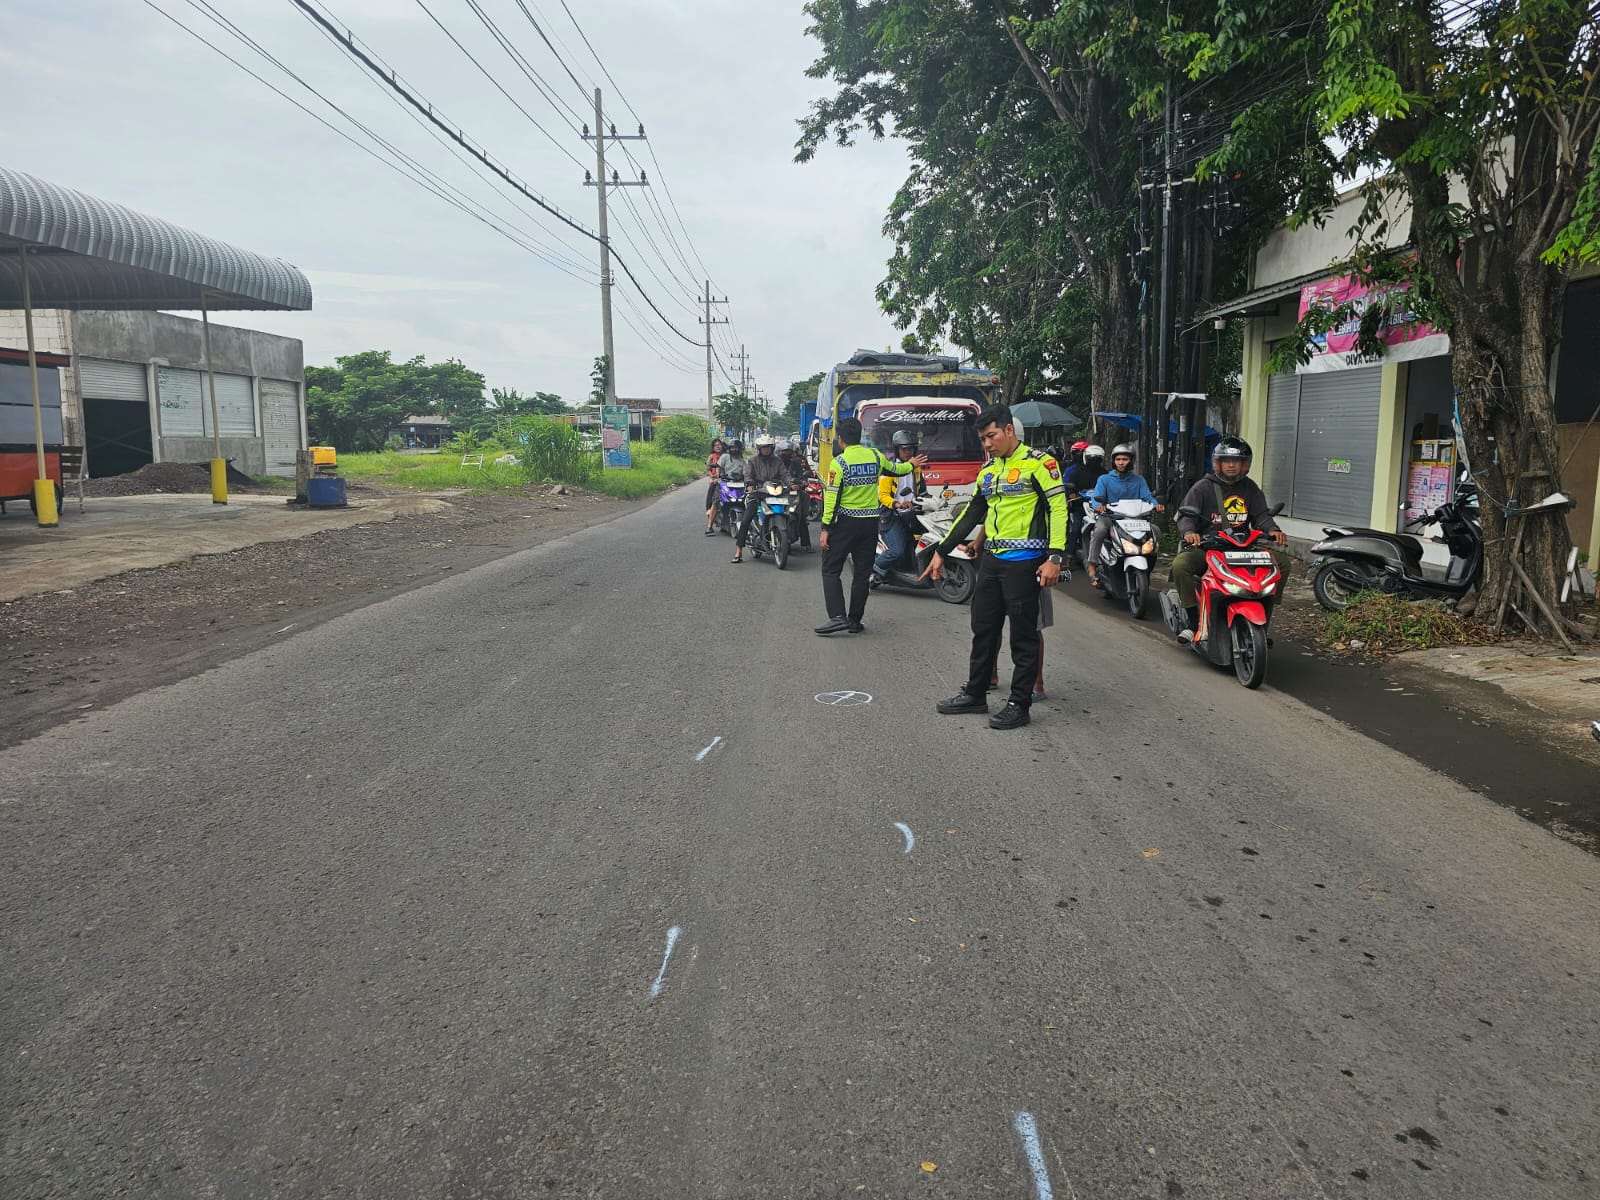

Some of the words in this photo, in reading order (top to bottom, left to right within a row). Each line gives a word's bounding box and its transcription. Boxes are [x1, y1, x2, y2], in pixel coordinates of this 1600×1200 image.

[1345, 353, 1363, 365] DIVA
[874, 409, 965, 422] Bismillah
[850, 464, 877, 476] POLISI
